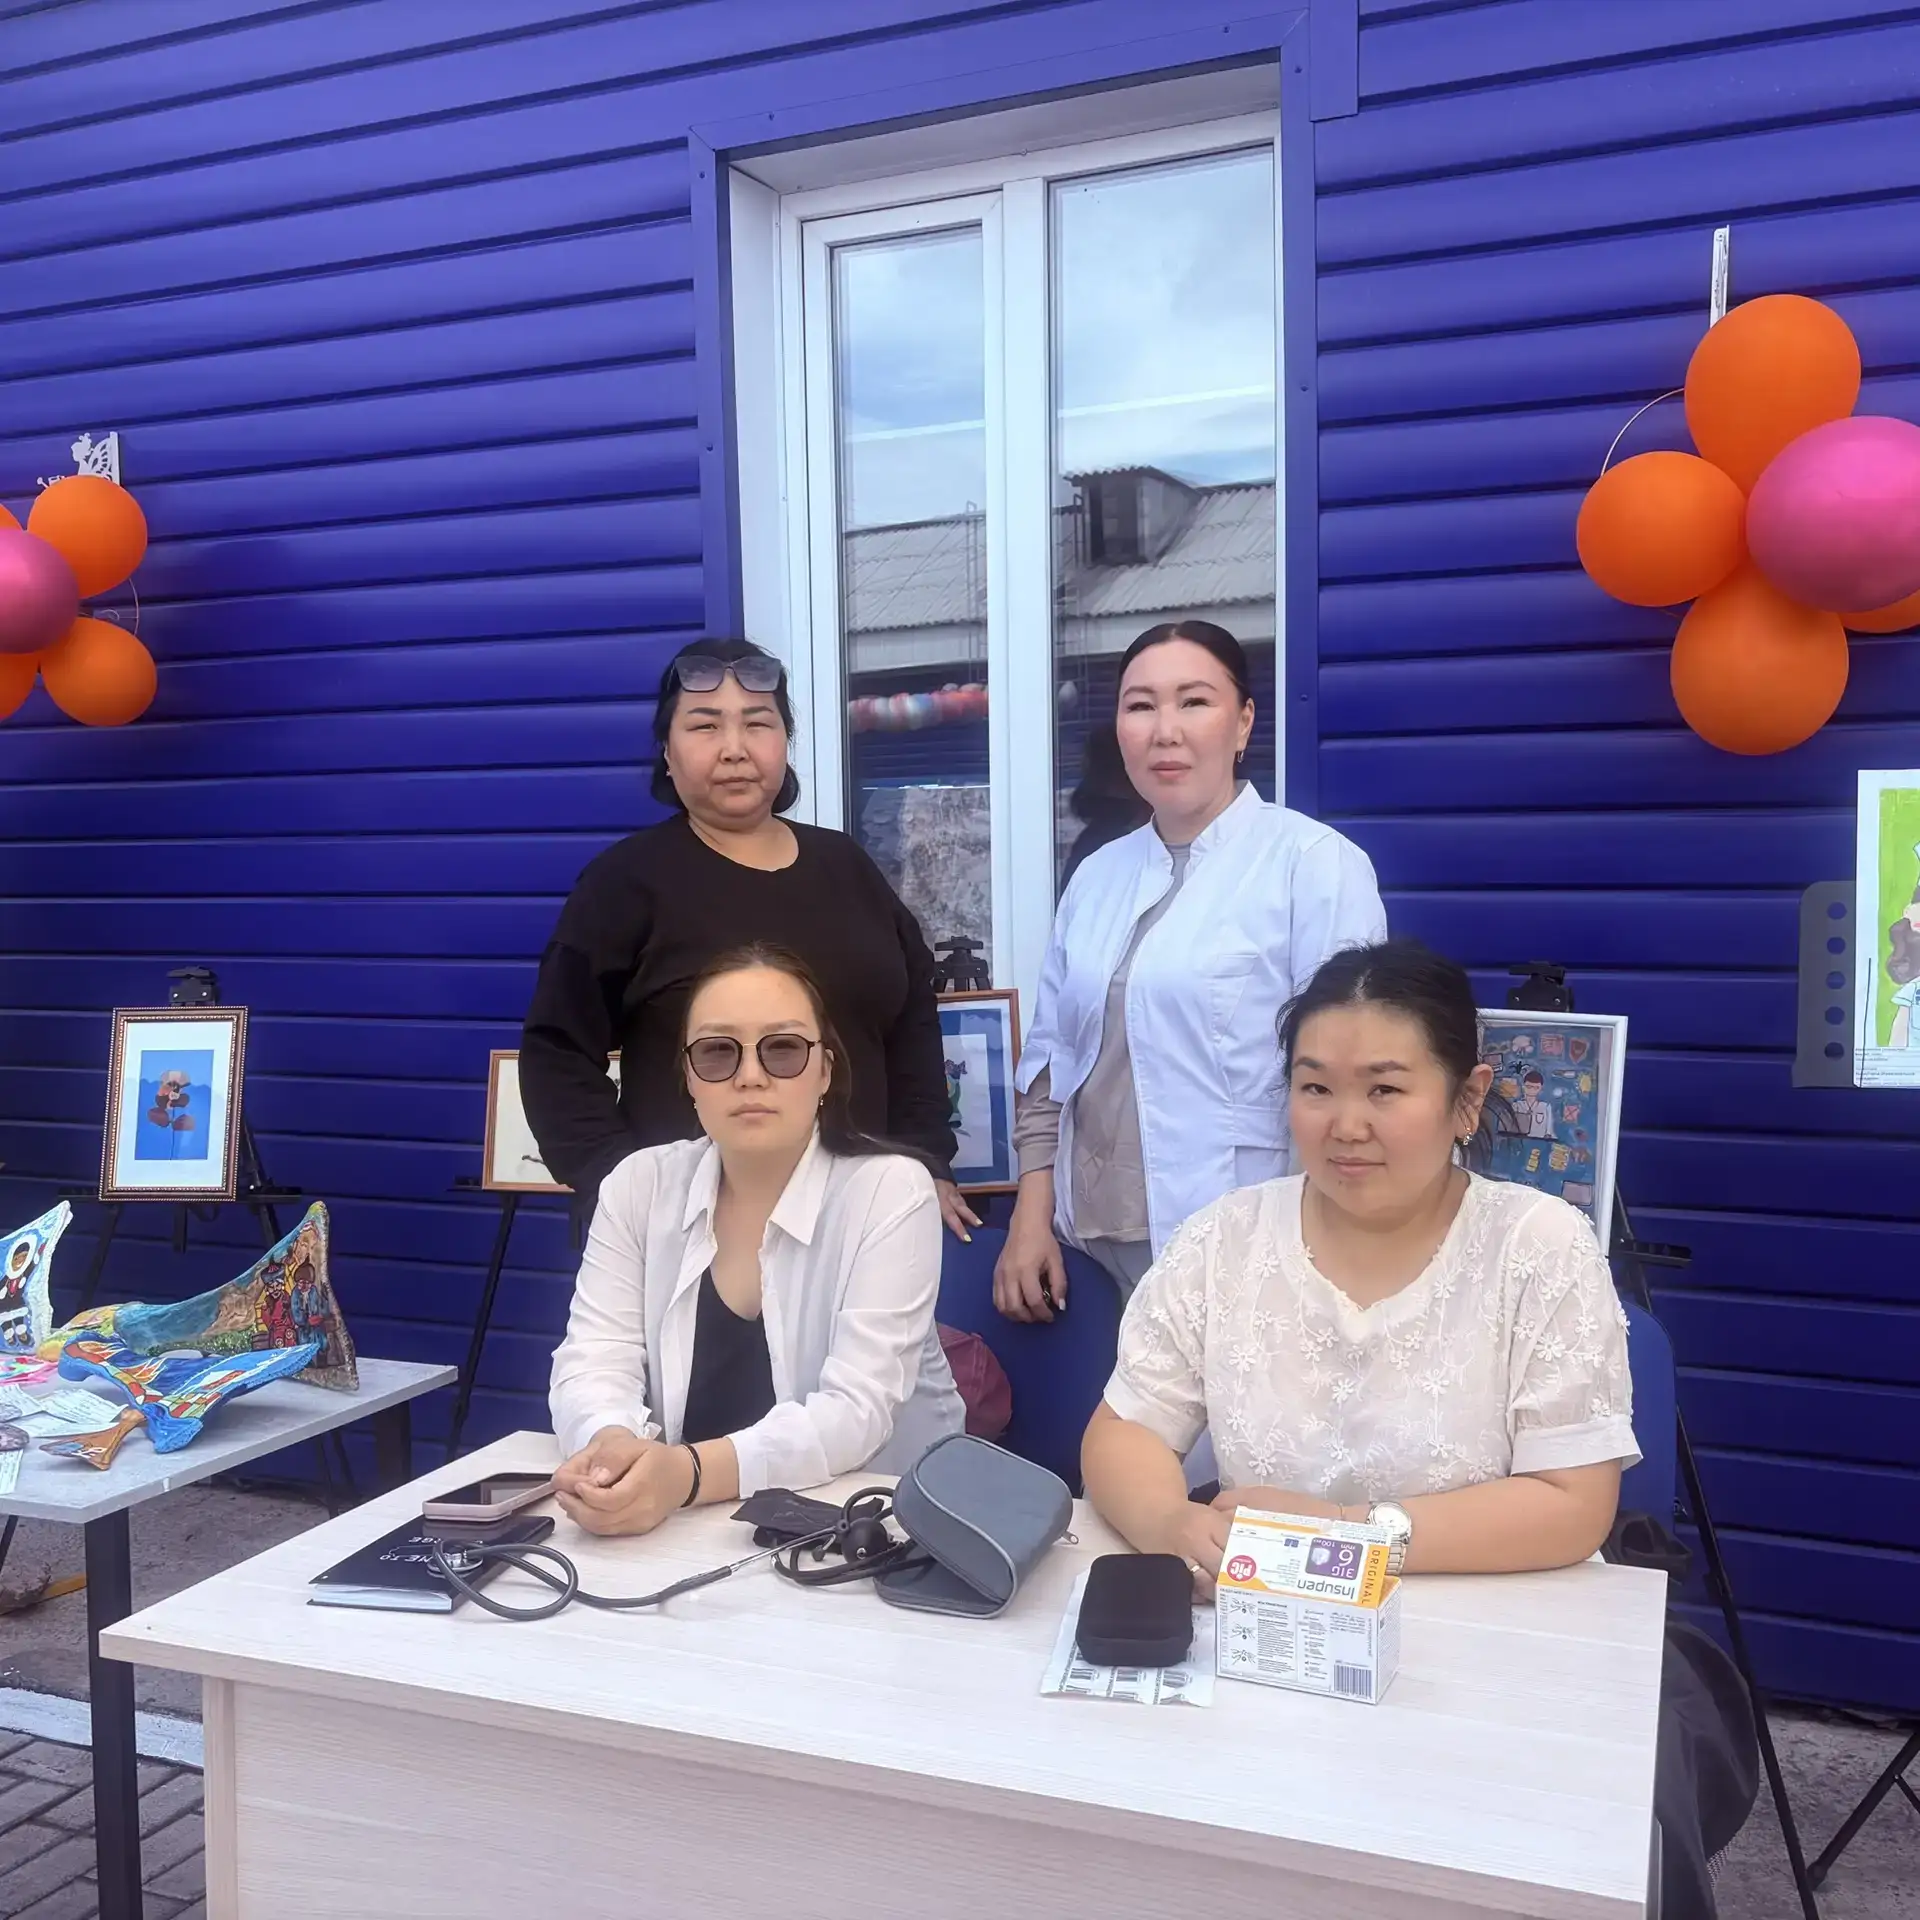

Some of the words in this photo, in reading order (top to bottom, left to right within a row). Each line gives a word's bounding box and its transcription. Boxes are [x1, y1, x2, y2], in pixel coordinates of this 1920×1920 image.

[1338, 1549, 1354, 1567] 6
[1331, 1566, 1355, 1578] 31G
[1361, 1549, 1381, 1604] ORIGINAL
[1297, 1579, 1355, 1600] Insupen
